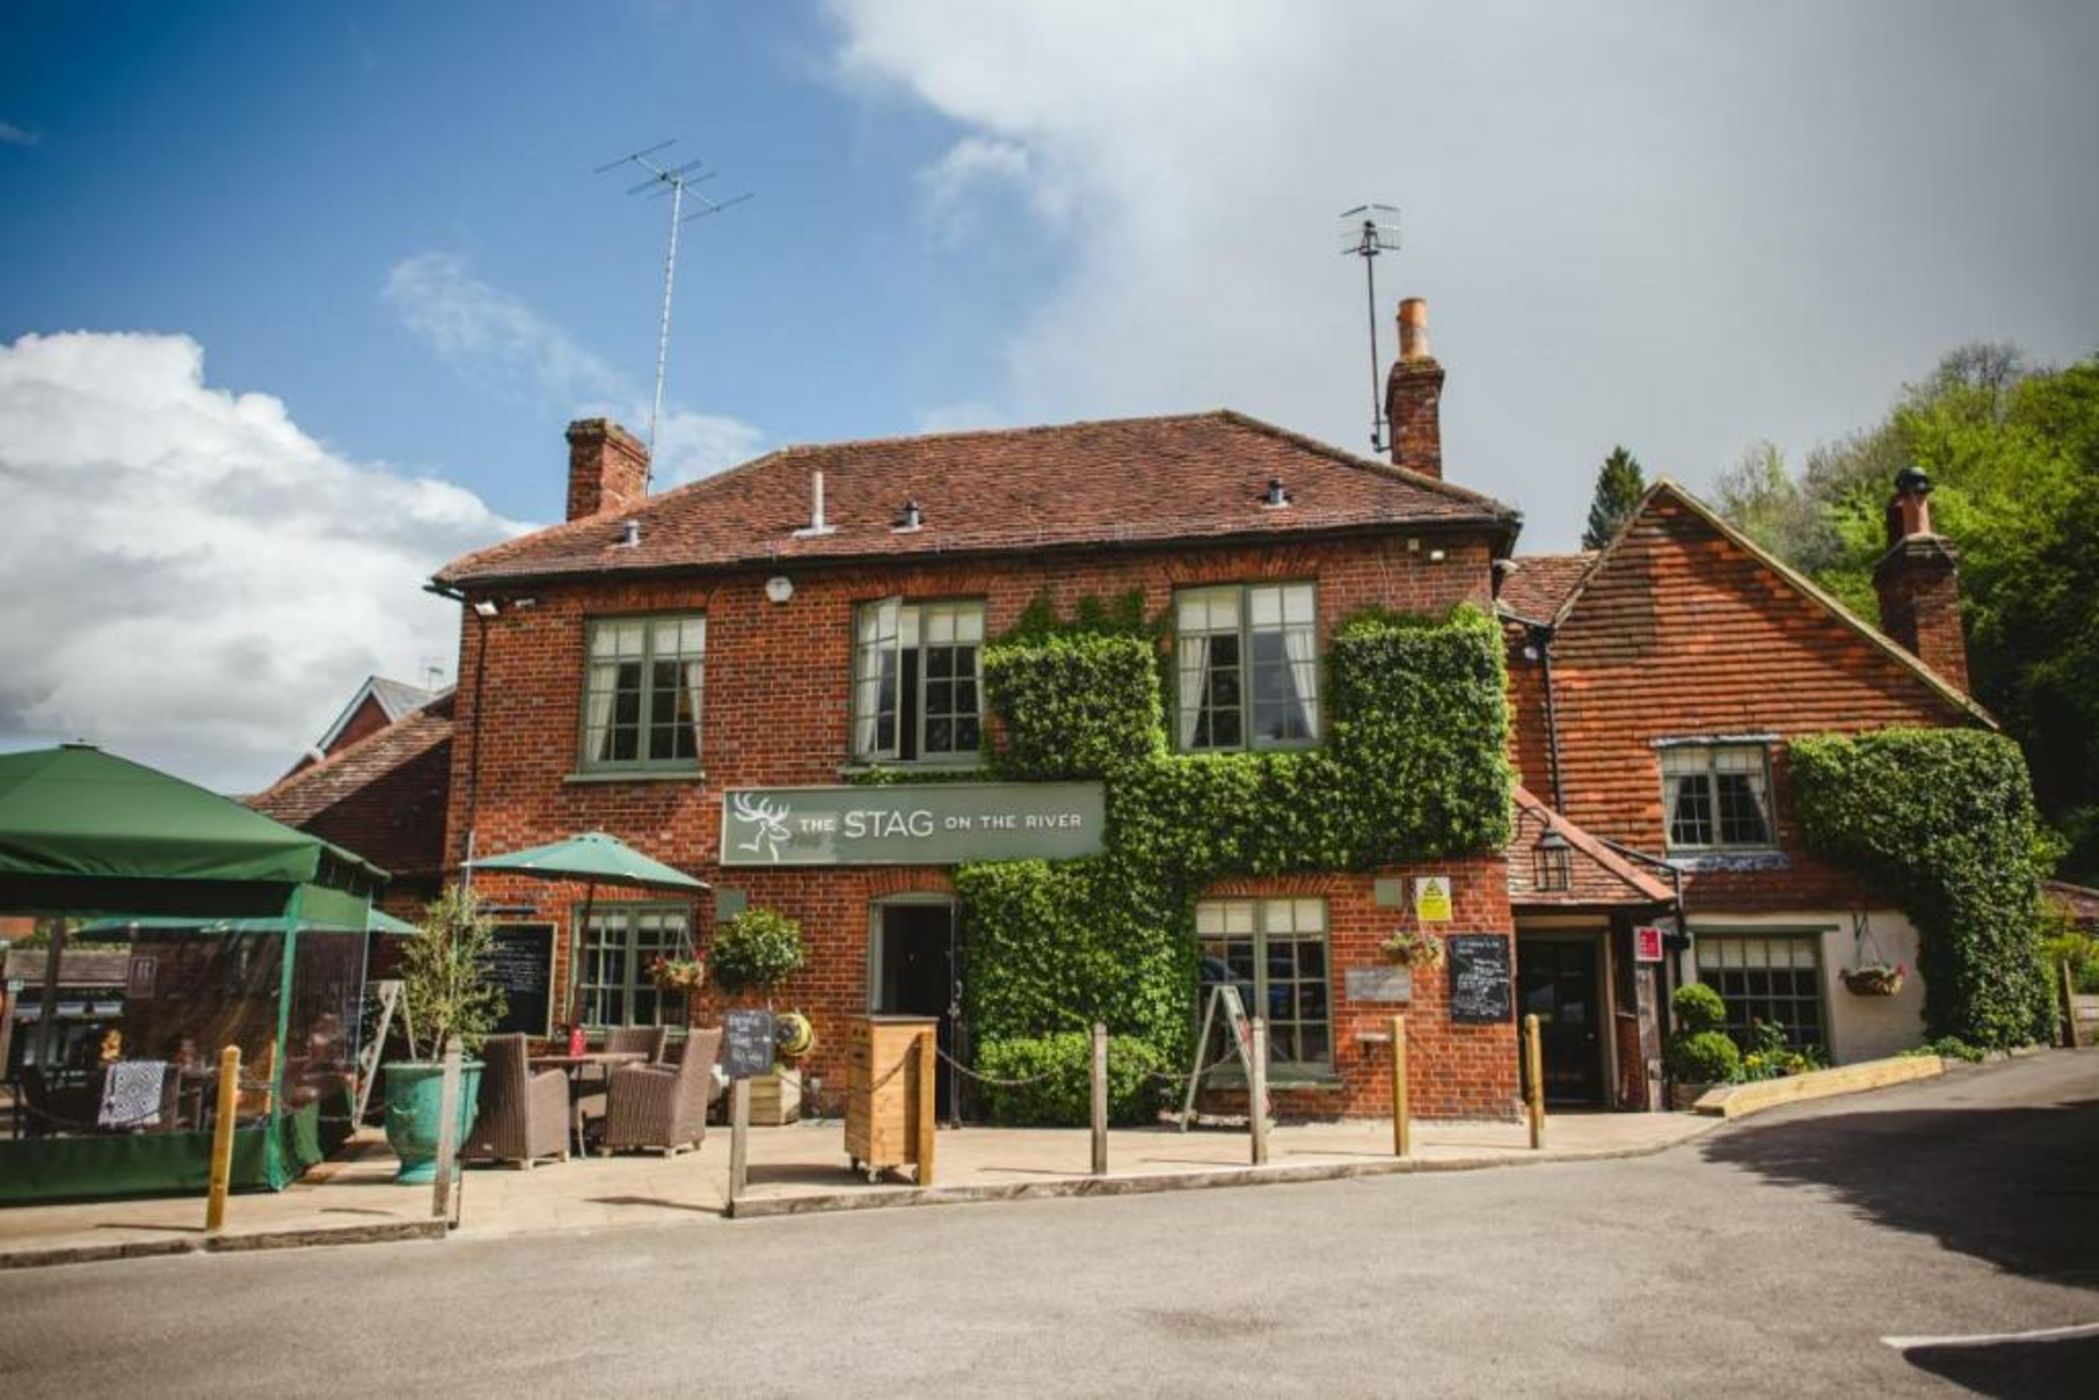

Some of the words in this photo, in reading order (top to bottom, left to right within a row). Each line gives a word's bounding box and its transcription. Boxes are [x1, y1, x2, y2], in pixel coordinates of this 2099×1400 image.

[800, 819, 835, 832] THE
[844, 809, 934, 838] STAG
[944, 816, 971, 829] ON
[980, 815, 1017, 829] THE
[1025, 814, 1082, 828] RIVER
